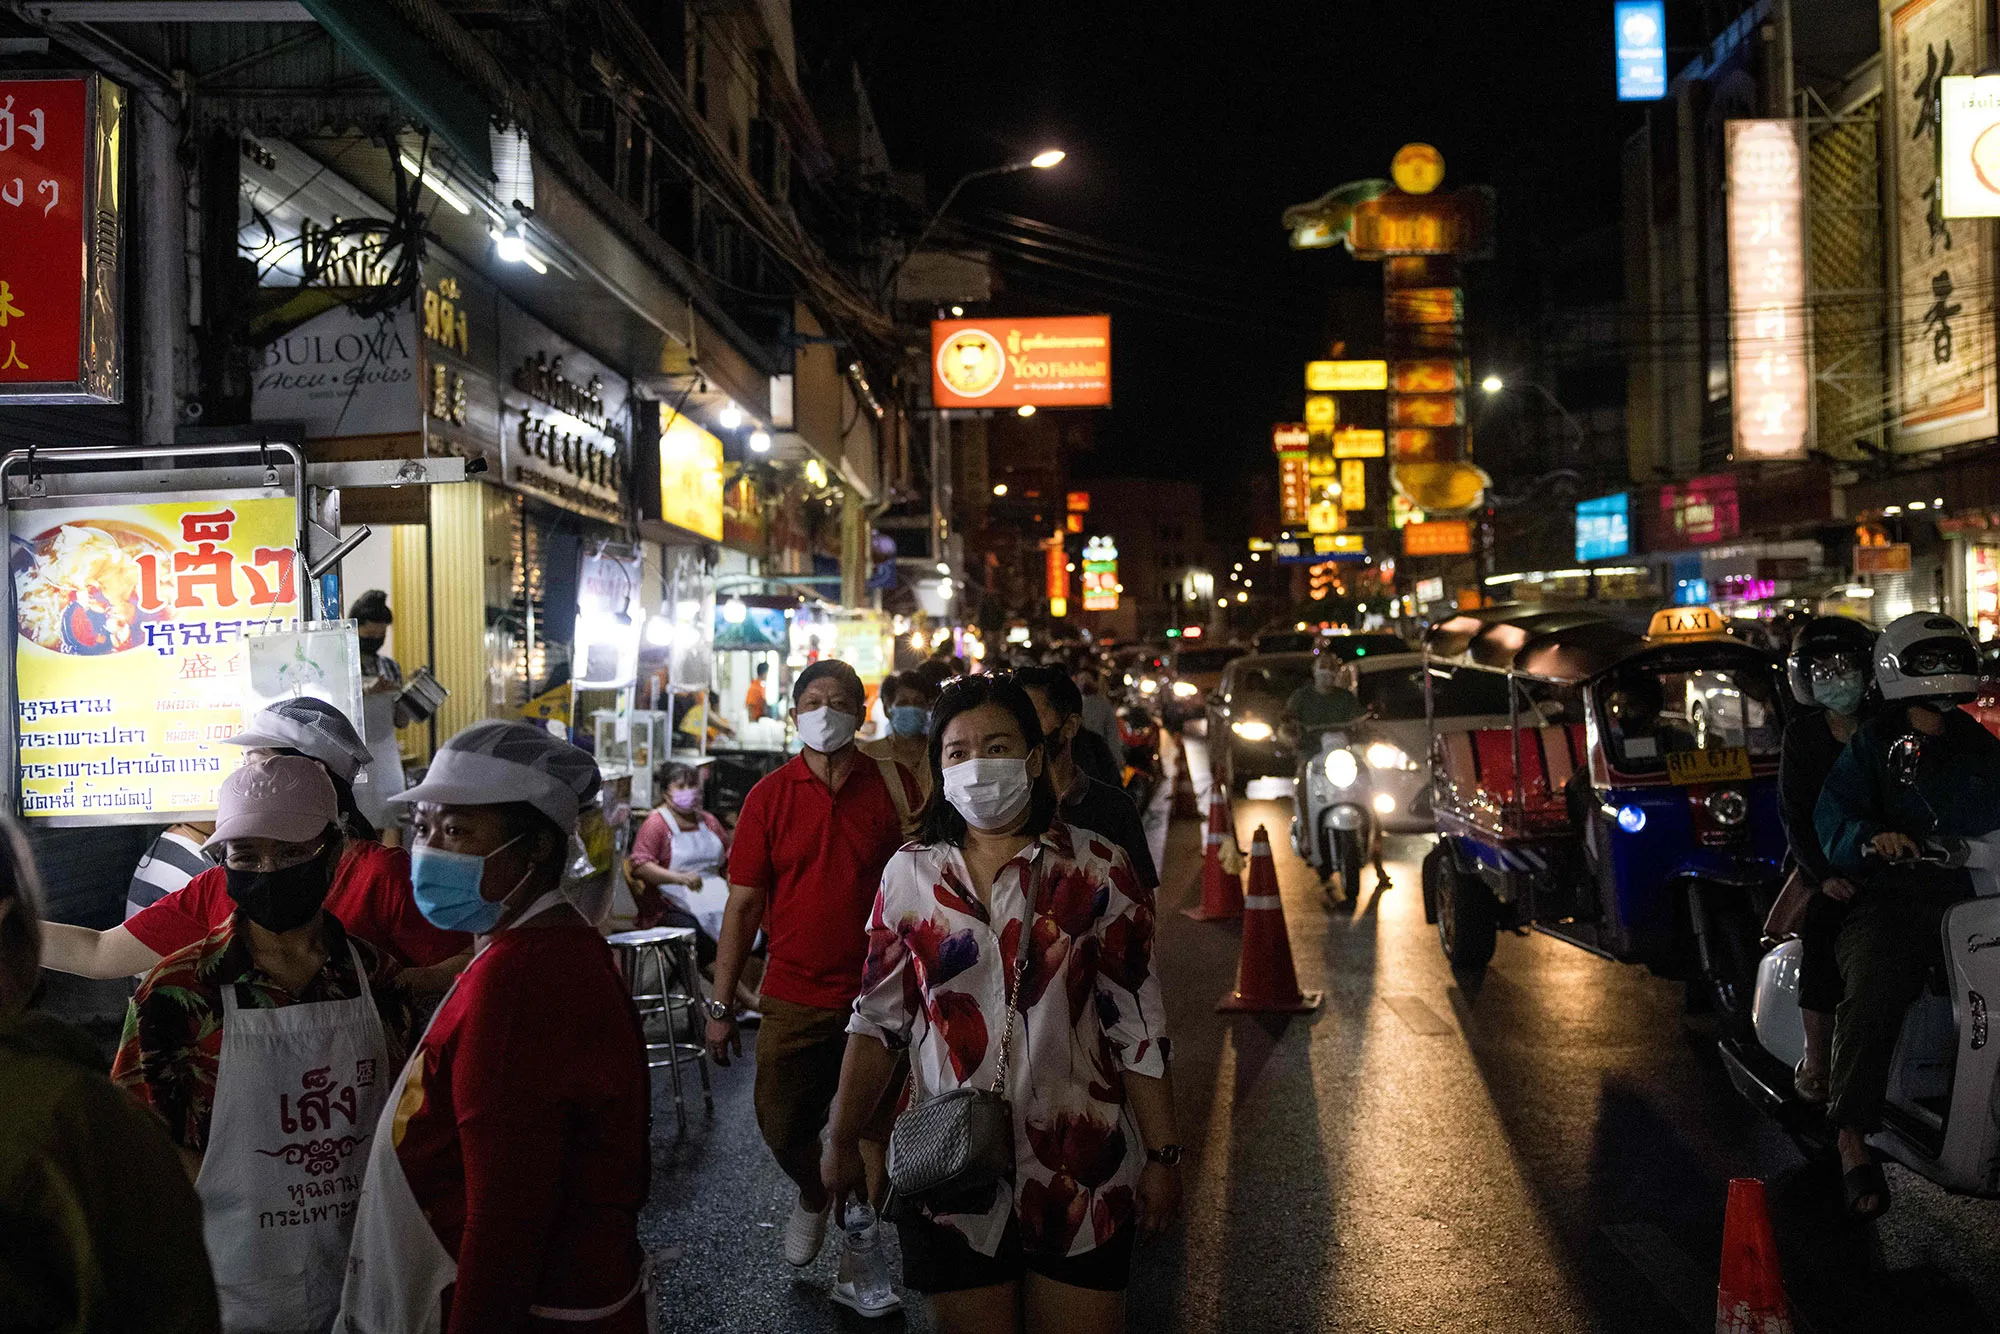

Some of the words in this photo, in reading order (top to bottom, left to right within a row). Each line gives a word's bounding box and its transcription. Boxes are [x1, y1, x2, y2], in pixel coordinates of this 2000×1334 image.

[135, 508, 298, 610] เส็ง
[1661, 612, 1711, 632] TAXI
[20, 699, 112, 721] หูฉลาม
[20, 726, 145, 748] กระเพาะปลา
[280, 1064, 357, 1134] เส็ง
[287, 1174, 359, 1207] หูฉลาม
